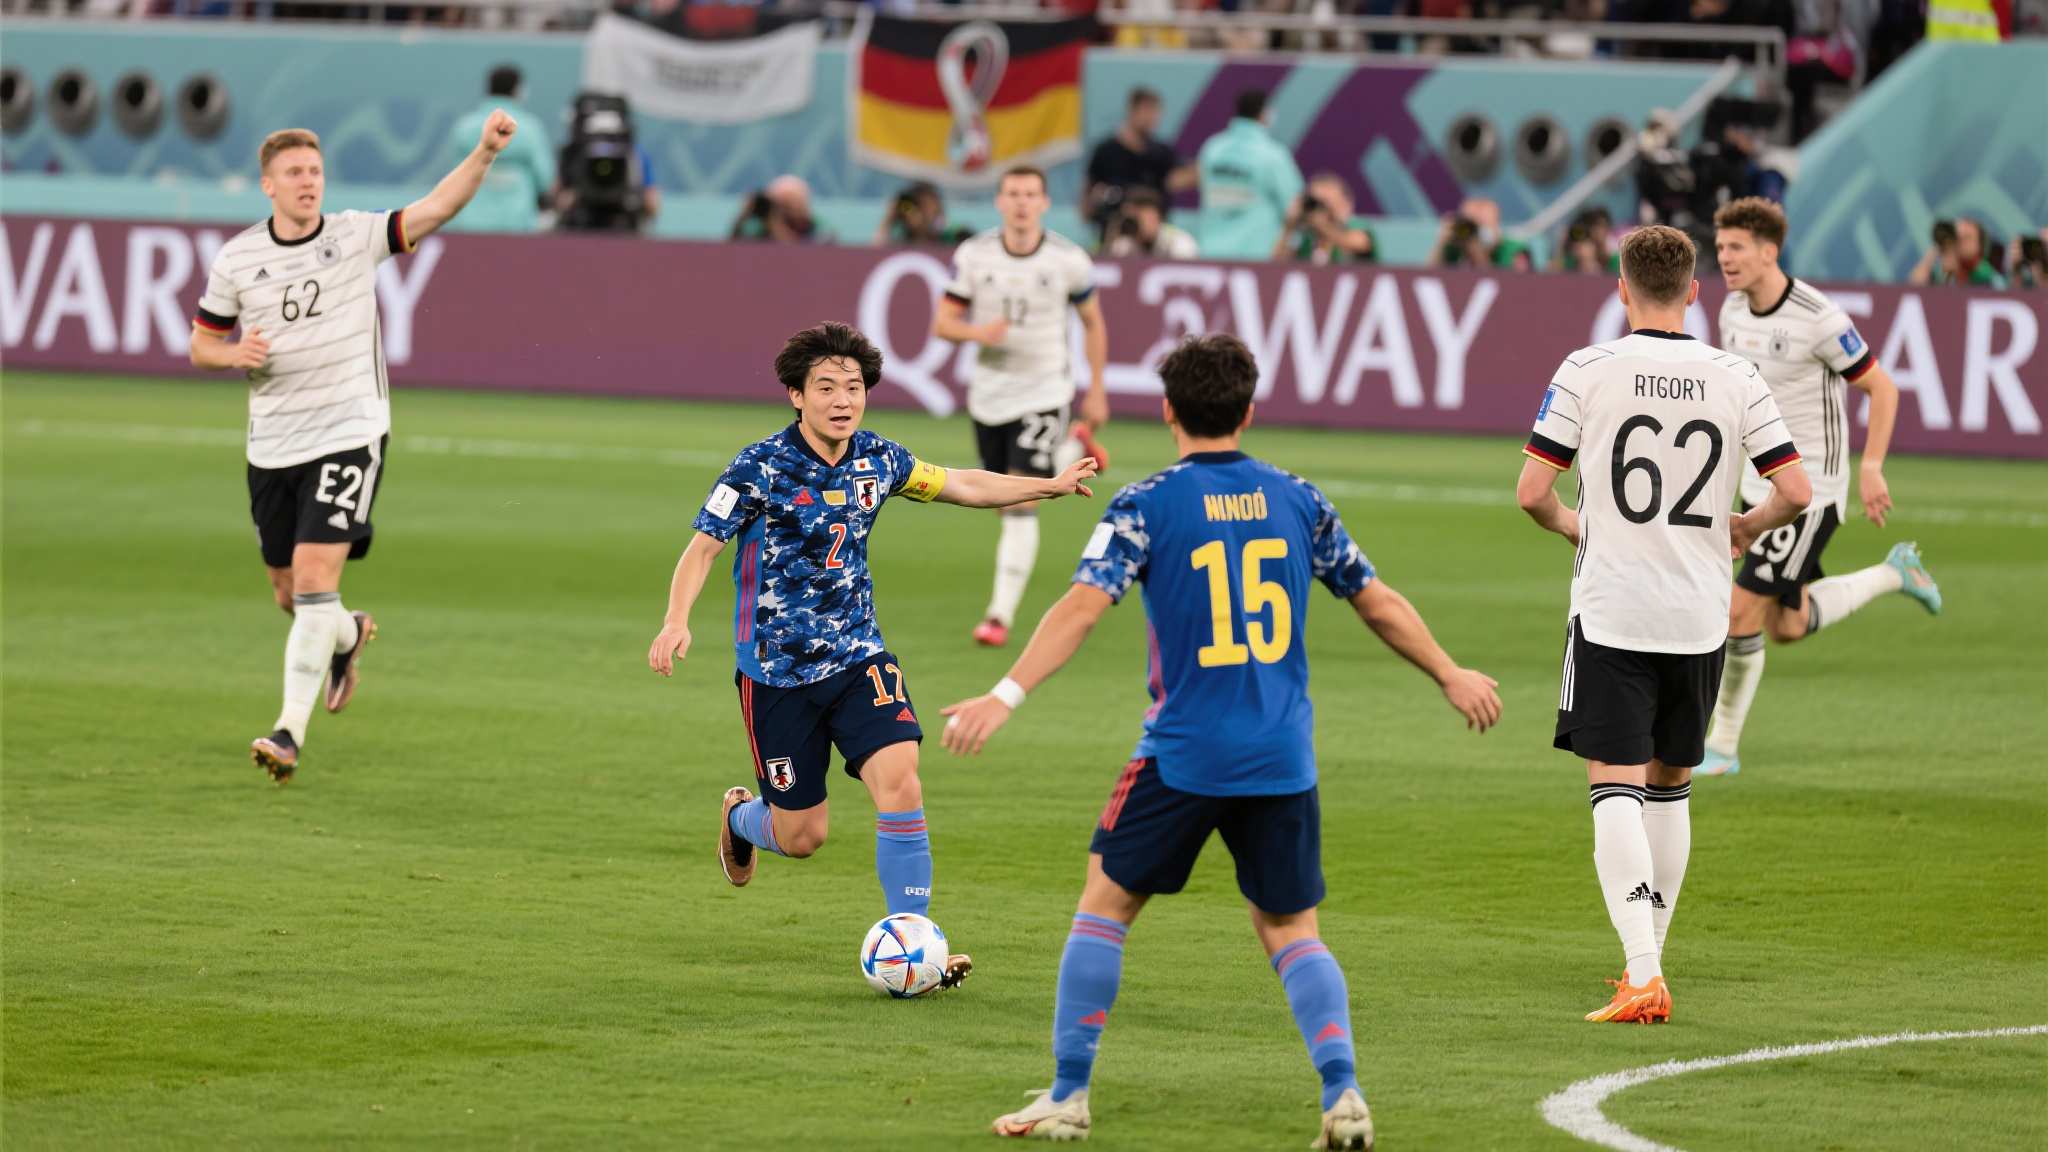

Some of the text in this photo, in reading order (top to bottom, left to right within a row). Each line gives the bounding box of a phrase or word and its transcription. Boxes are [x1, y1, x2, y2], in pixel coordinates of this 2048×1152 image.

[282, 279, 322, 322] 62
[1611, 414, 1723, 529] 62
[826, 523, 847, 570] 2
[1190, 538, 1292, 668] 15
